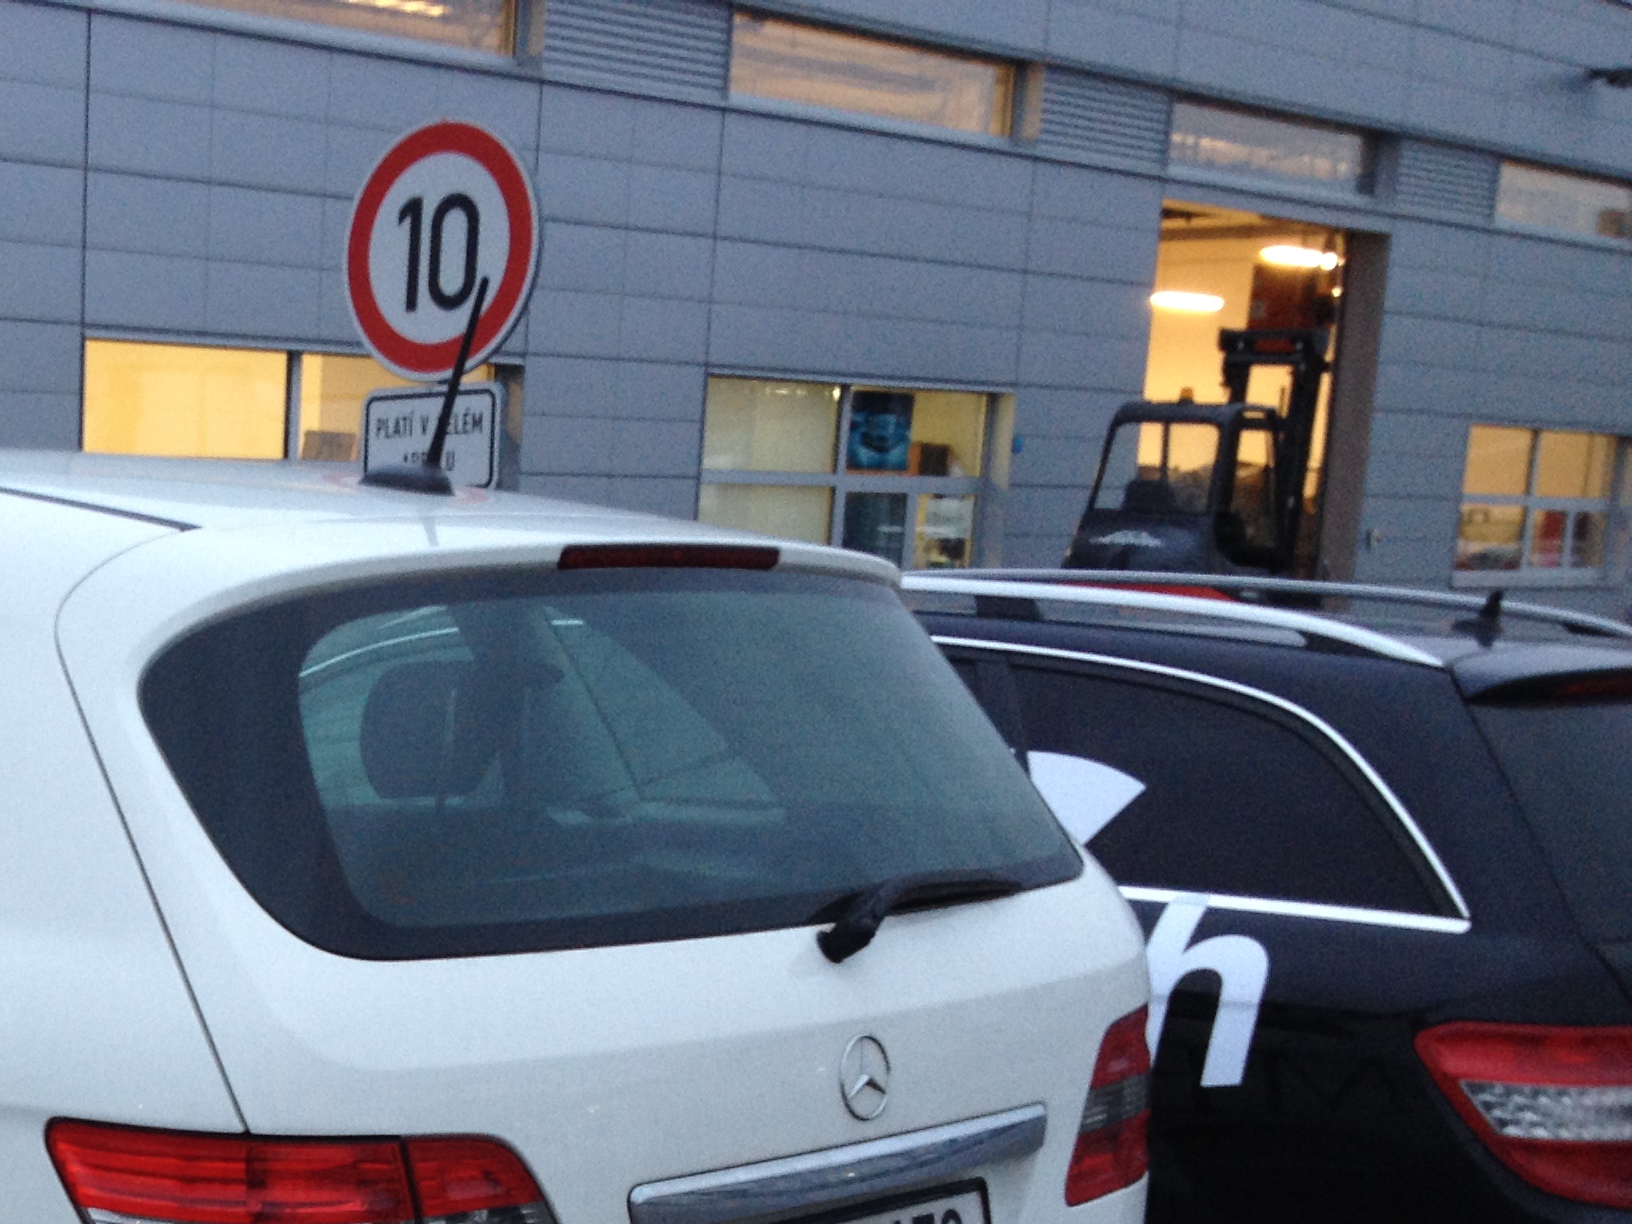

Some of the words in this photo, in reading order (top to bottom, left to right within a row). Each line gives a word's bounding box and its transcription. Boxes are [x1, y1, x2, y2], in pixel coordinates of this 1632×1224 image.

[398, 192, 480, 312] 10
[376, 409, 414, 439] PLATÍ
[421, 414, 429, 435] V
[439, 407, 483, 436] ELÉM
